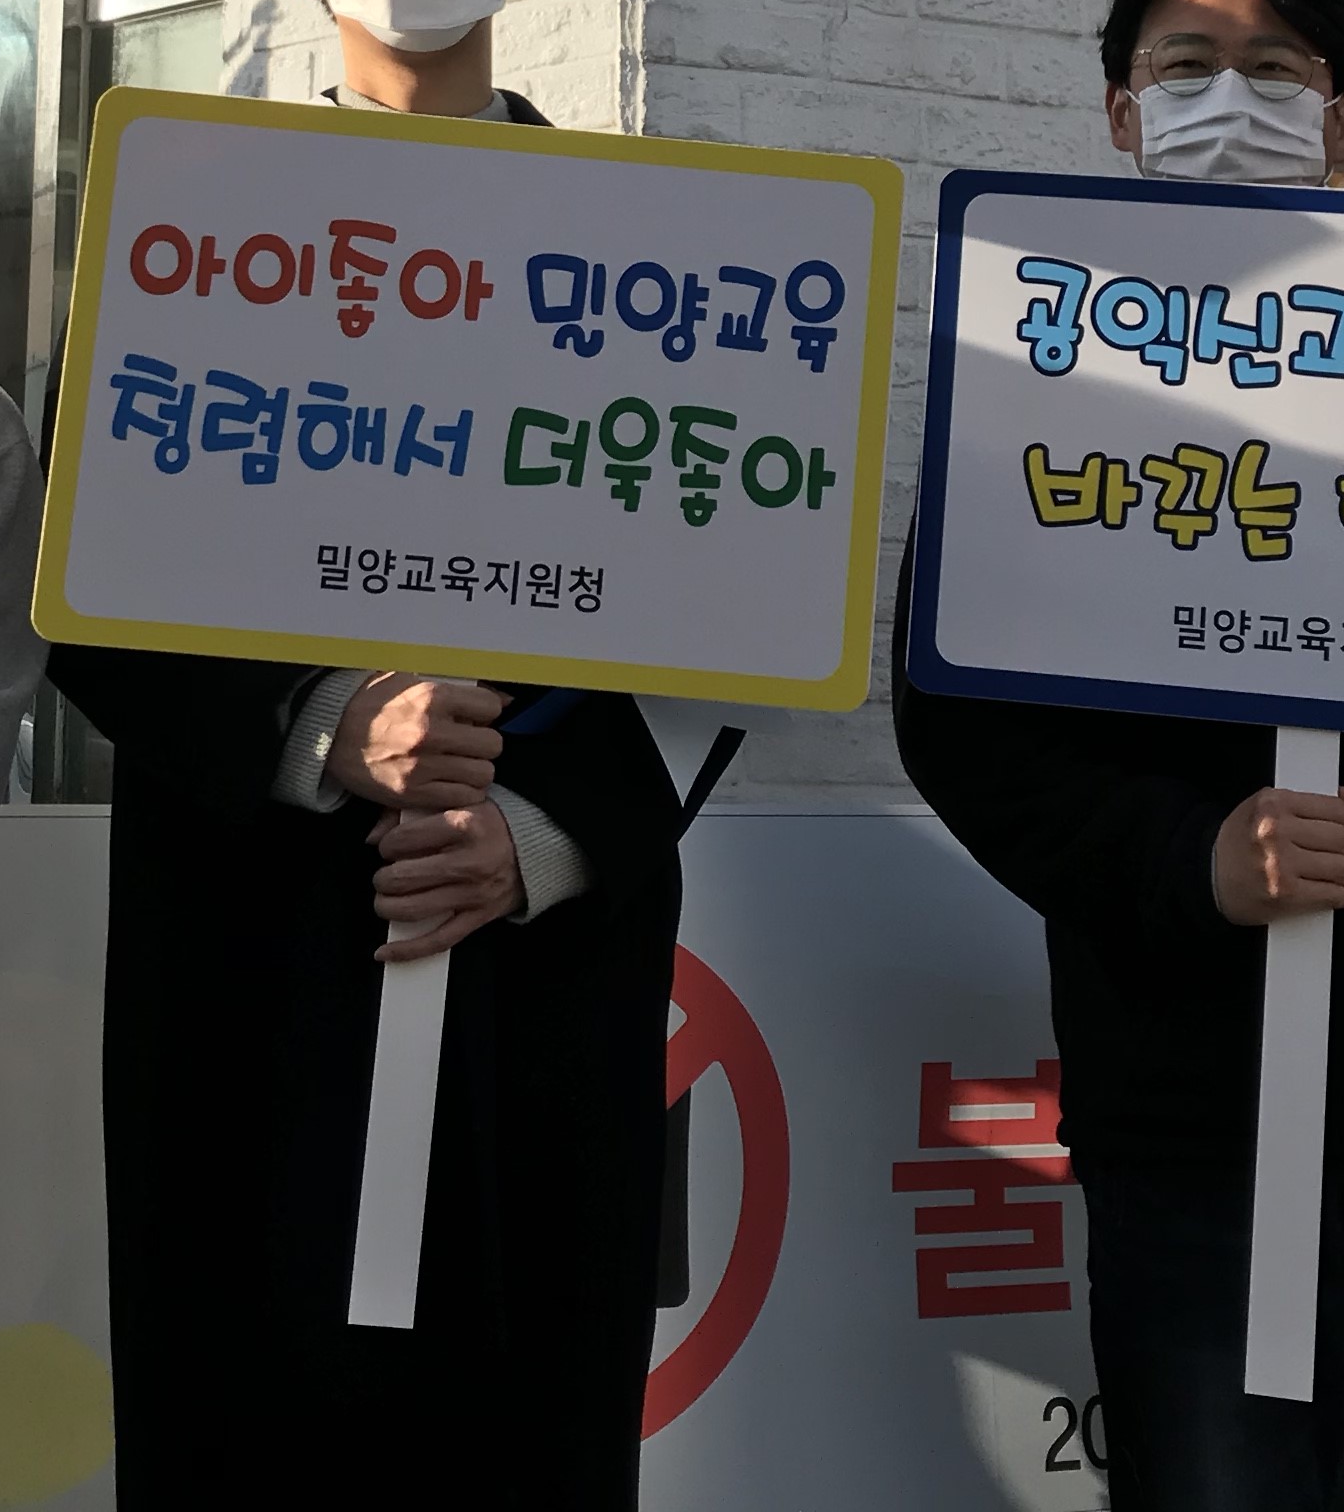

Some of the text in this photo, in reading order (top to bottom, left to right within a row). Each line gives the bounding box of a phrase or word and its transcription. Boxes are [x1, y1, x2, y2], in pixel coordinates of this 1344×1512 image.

[129, 218, 847, 373] 아이좋아 밀양교육
[109, 353, 837, 528] 청렴해서 더욱좋아
[1022, 437, 1302, 563] 바꾸는
[316, 543, 606, 614] 밀양교육지원청
